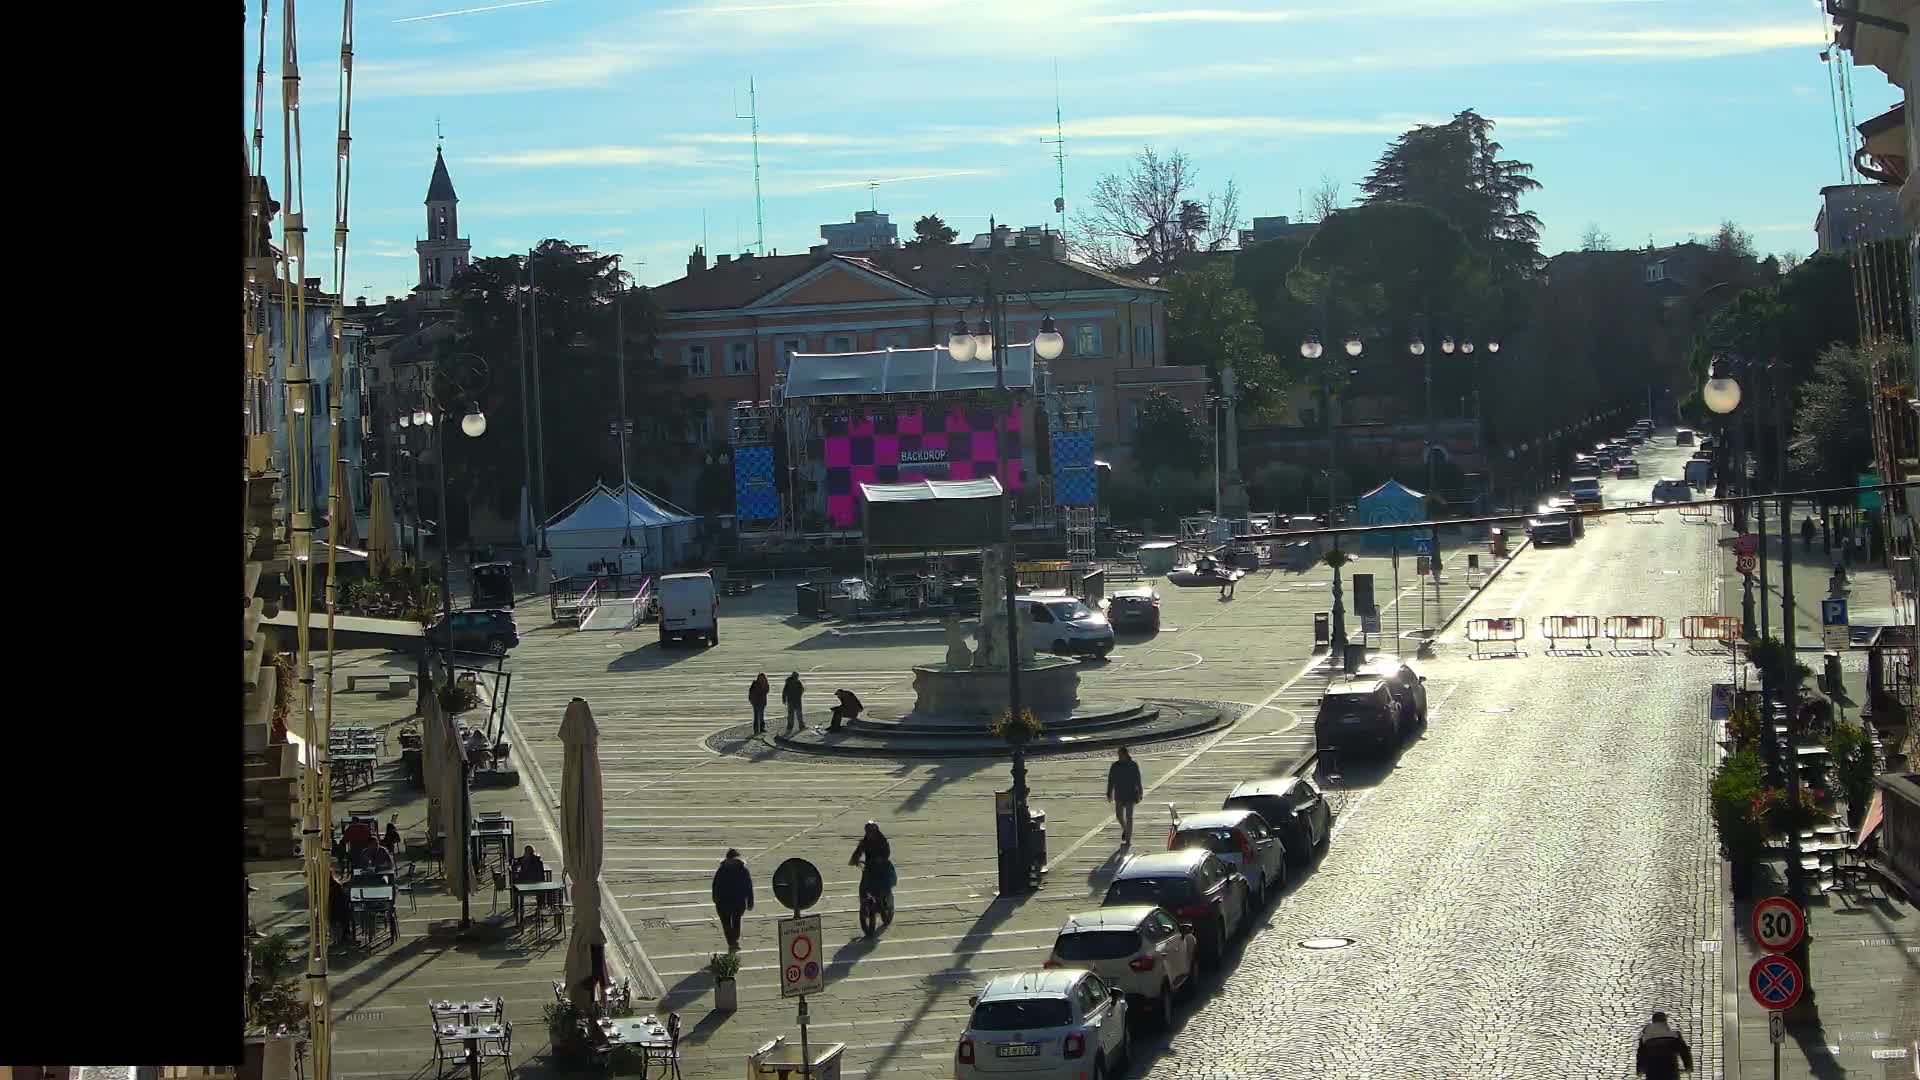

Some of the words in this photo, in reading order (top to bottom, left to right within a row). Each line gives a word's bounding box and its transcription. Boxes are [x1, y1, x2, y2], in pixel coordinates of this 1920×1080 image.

[900, 449, 946, 462] BACKDROP
[1742, 558, 1752, 568] 20
[1828, 602, 1842, 624] P
[1762, 912, 1792, 938] 30
